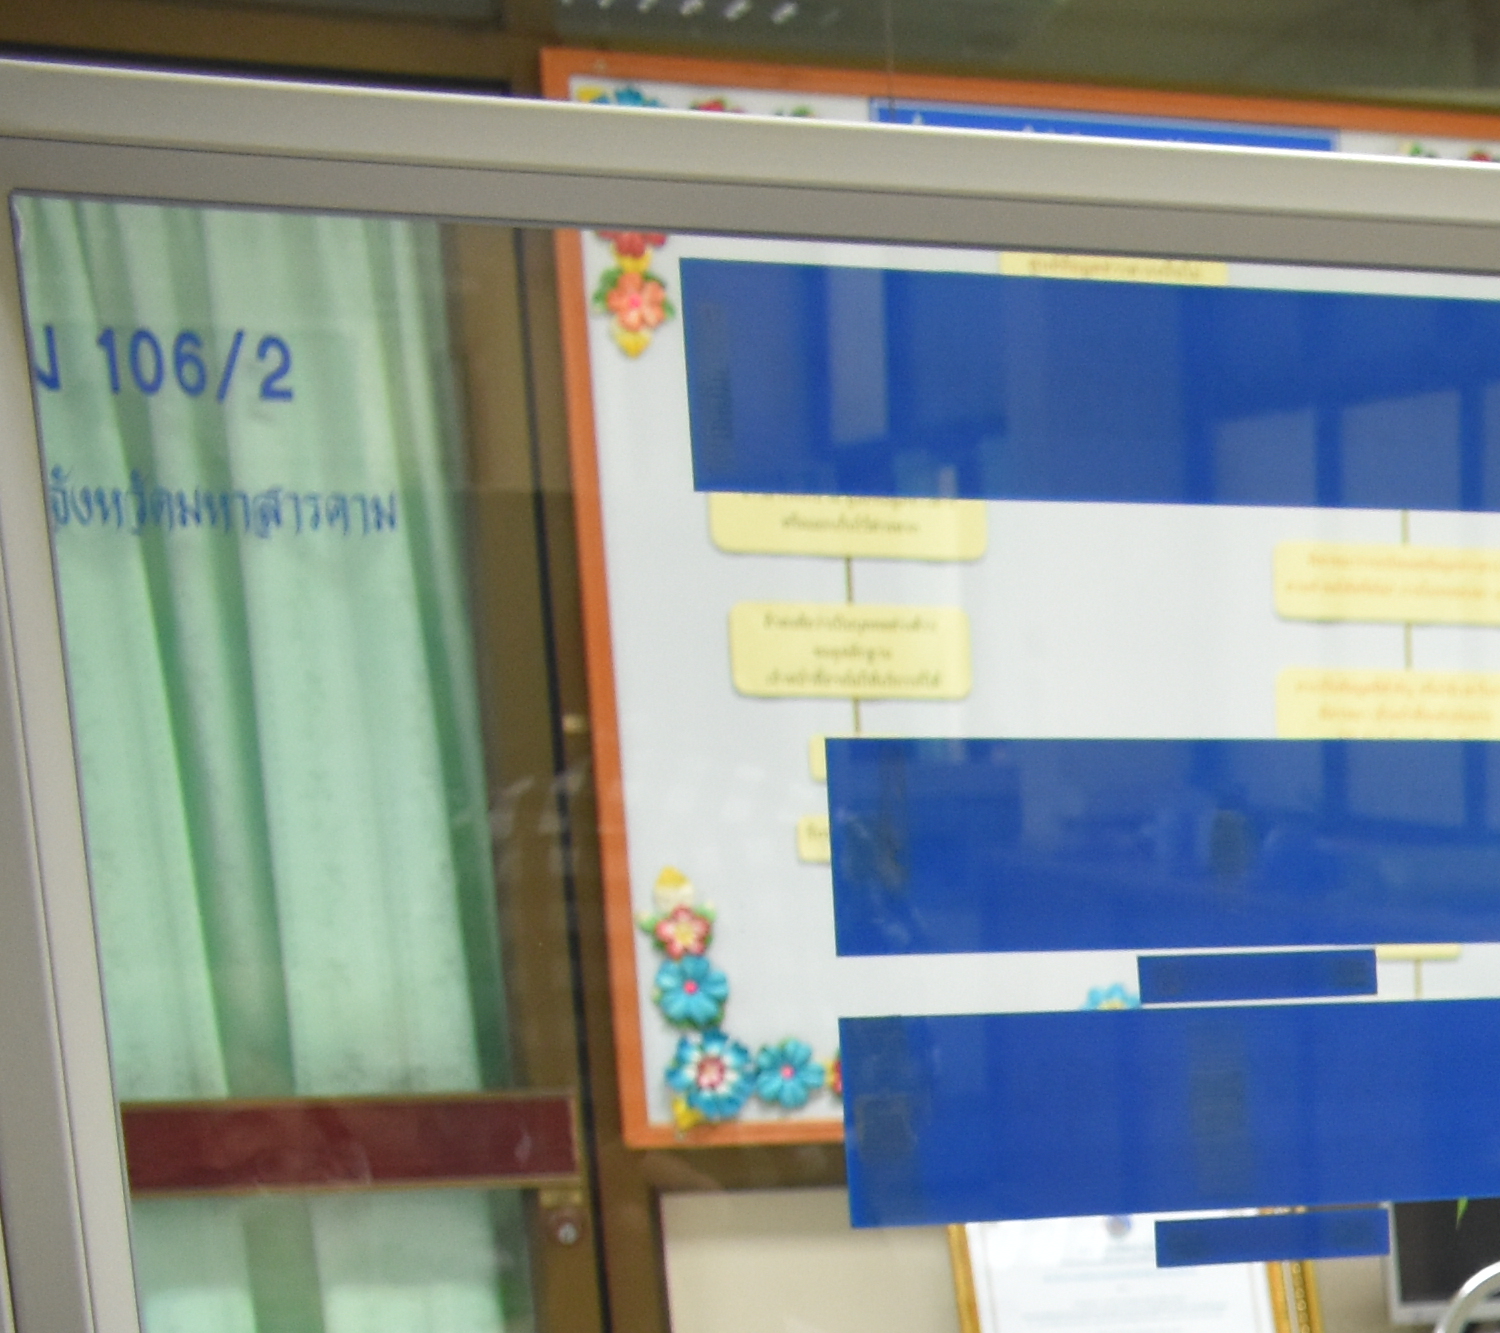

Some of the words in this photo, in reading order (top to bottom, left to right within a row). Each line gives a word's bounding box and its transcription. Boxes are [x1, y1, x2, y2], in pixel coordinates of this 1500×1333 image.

[97, 327, 294, 404] 106/2
[48, 463, 400, 538] จังหวัดมหาสารคาม
